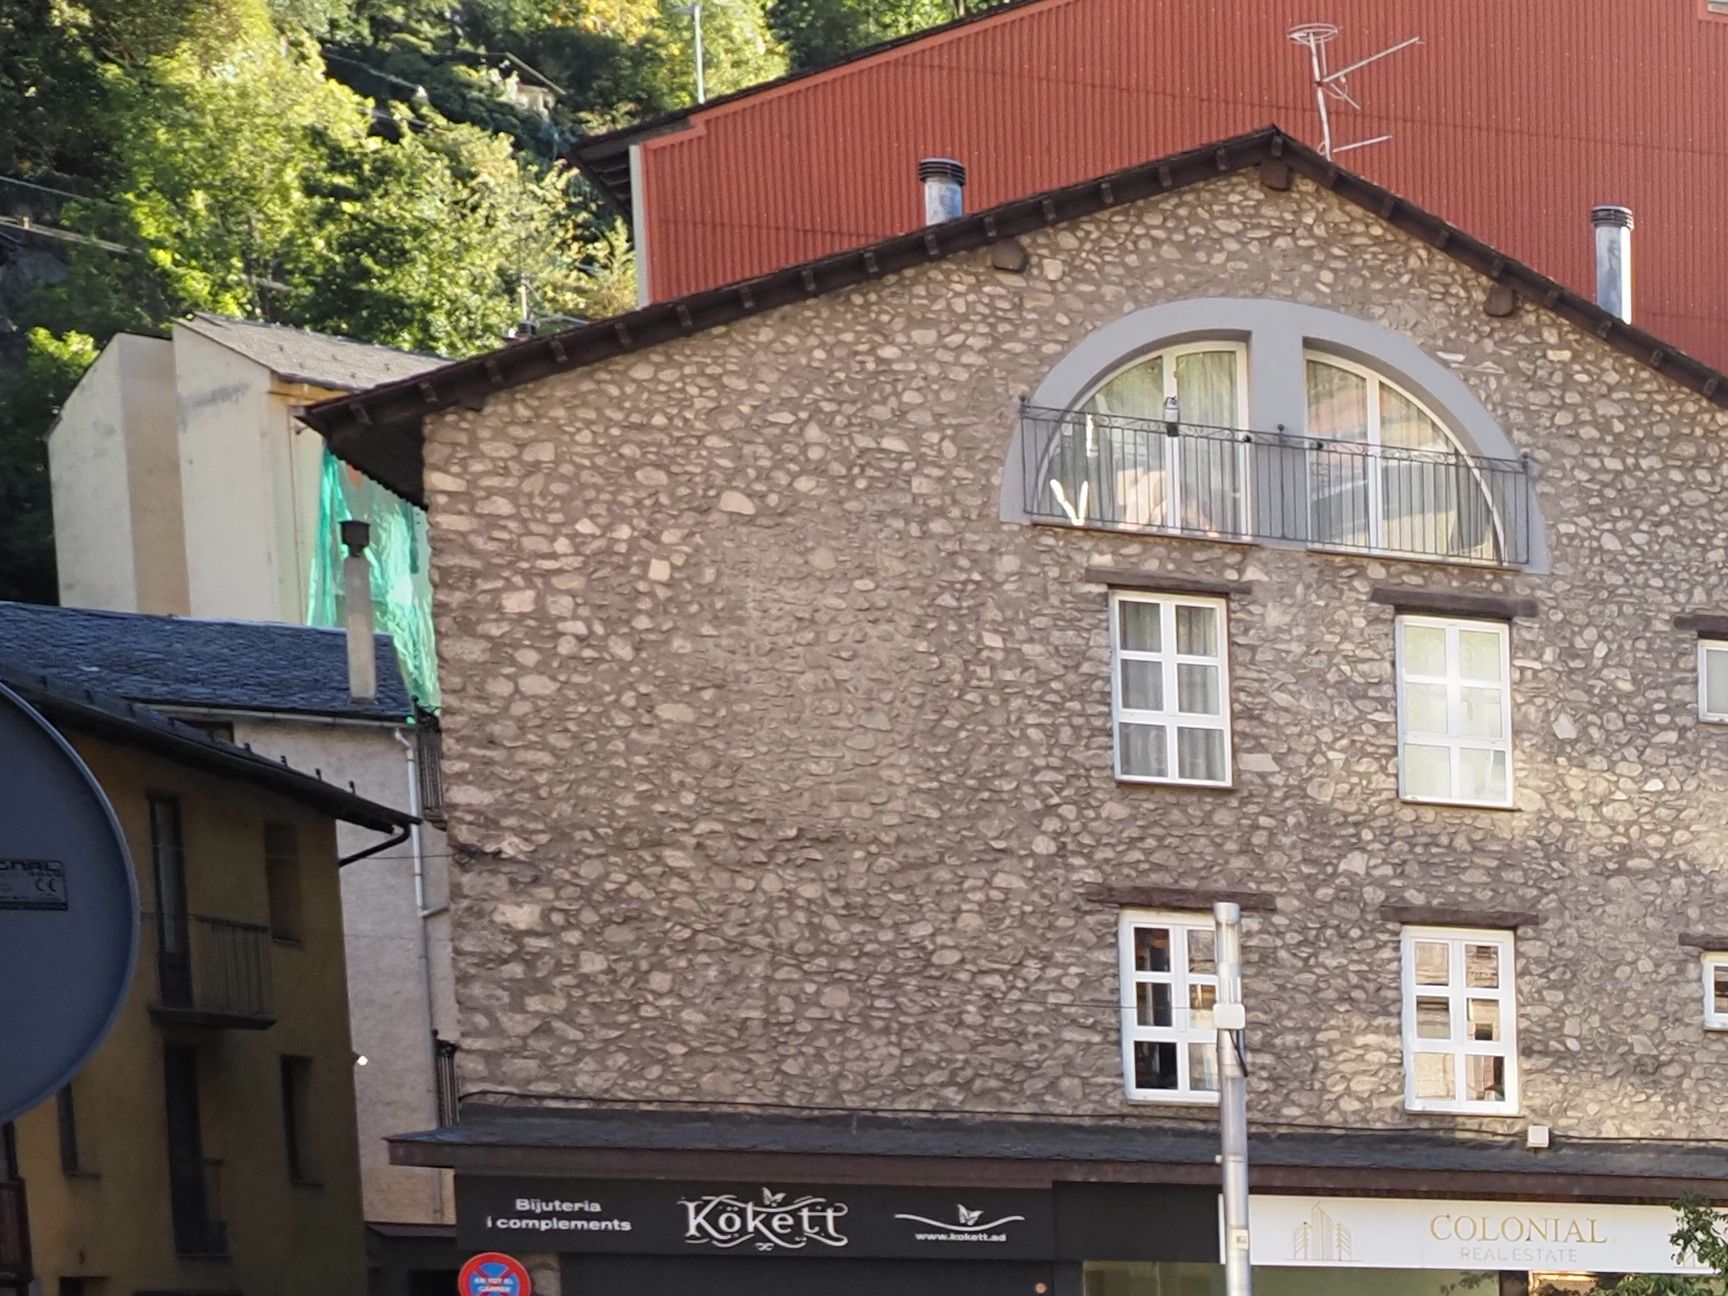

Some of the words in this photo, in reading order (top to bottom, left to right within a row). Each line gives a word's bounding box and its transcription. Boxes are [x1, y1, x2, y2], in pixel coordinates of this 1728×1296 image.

[515, 1198, 602, 1214] Bijuteria
[496, 1216, 633, 1232] complements
[1430, 1213, 1608, 1244] COLONIAL
[915, 1231, 1007, 1242] www.kokett.ad
[1460, 1247, 1510, 1262] REAL
[1512, 1249, 1578, 1263] ESTATE
